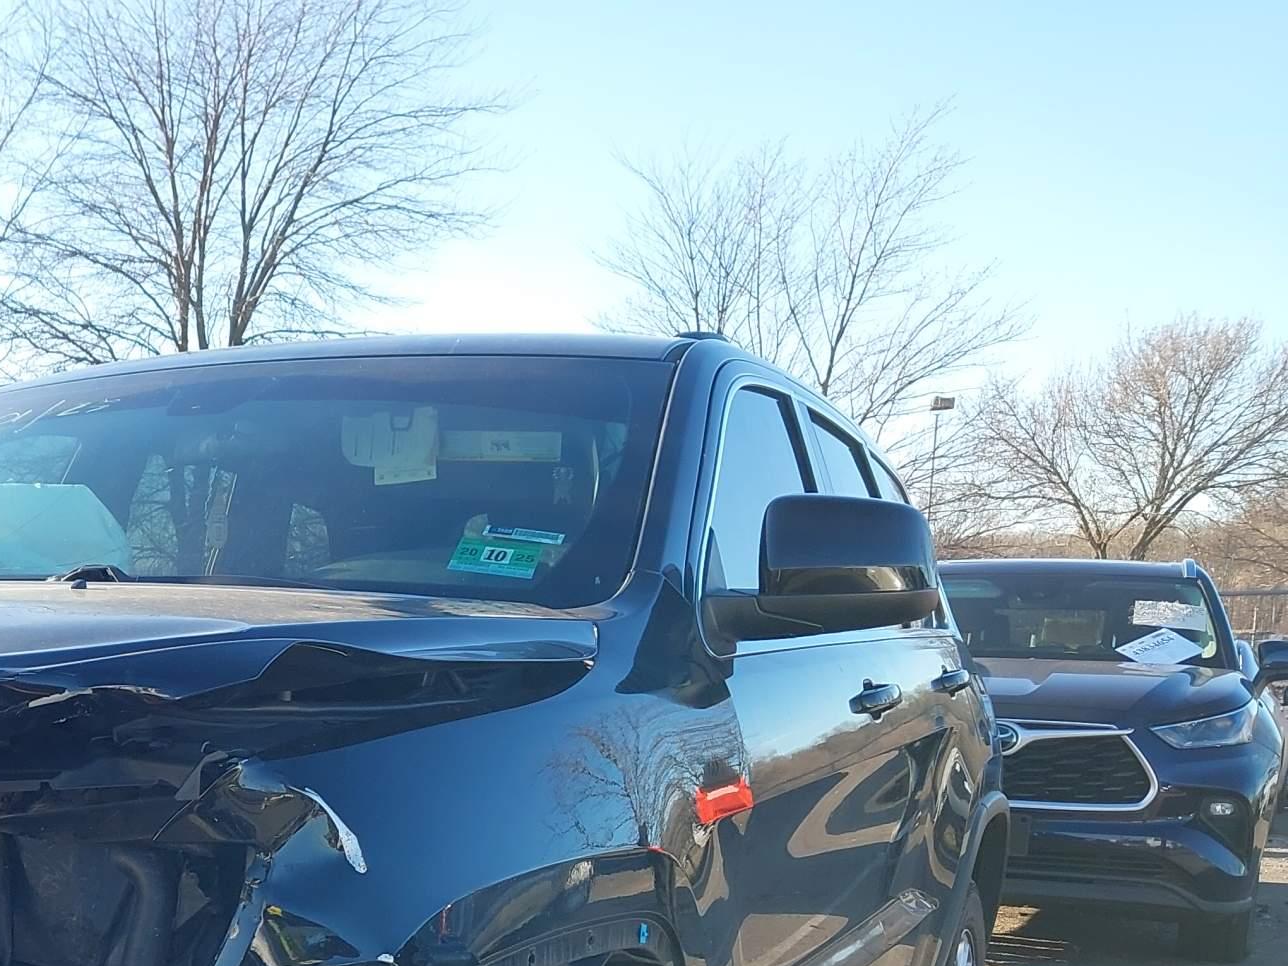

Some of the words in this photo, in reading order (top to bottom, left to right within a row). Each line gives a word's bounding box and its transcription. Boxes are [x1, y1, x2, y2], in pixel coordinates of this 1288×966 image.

[460, 547, 478, 556] 20
[485, 549, 508, 562] 10
[516, 554, 534, 563] 25
